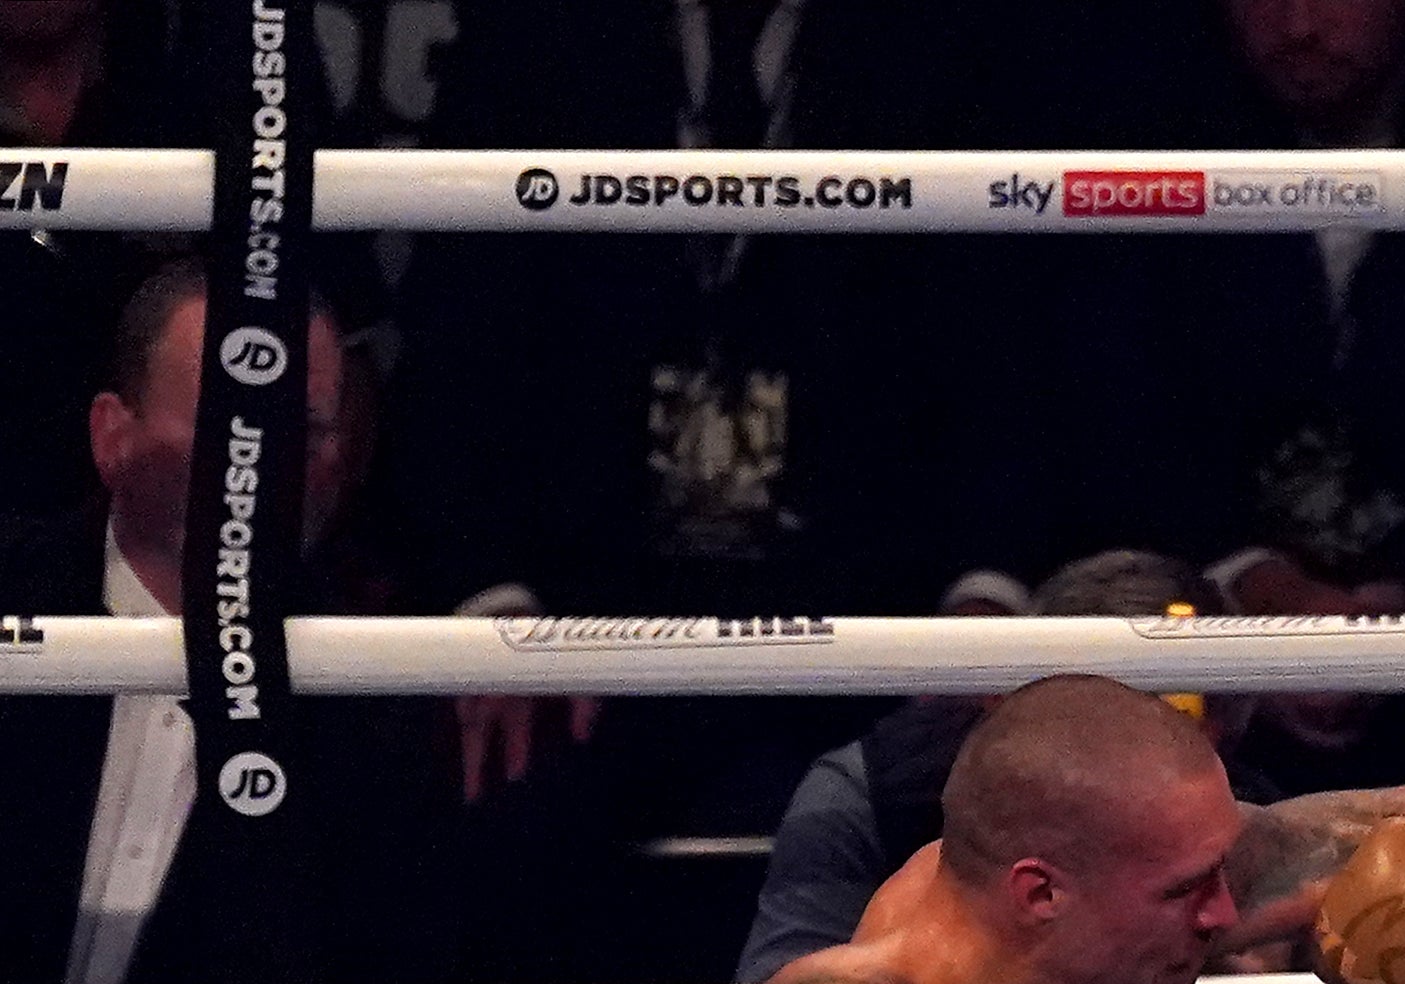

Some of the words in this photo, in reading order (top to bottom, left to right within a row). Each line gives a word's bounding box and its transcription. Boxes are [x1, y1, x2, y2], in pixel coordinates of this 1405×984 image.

[569, 174, 913, 209] JDSPORTS.COM
[988, 172, 1055, 214] sky
[1069, 177, 1200, 214] sports
[1213, 180, 1271, 207] box
[1279, 176, 1379, 207] office
[216, 415, 264, 721] JDSPORTS.COM
